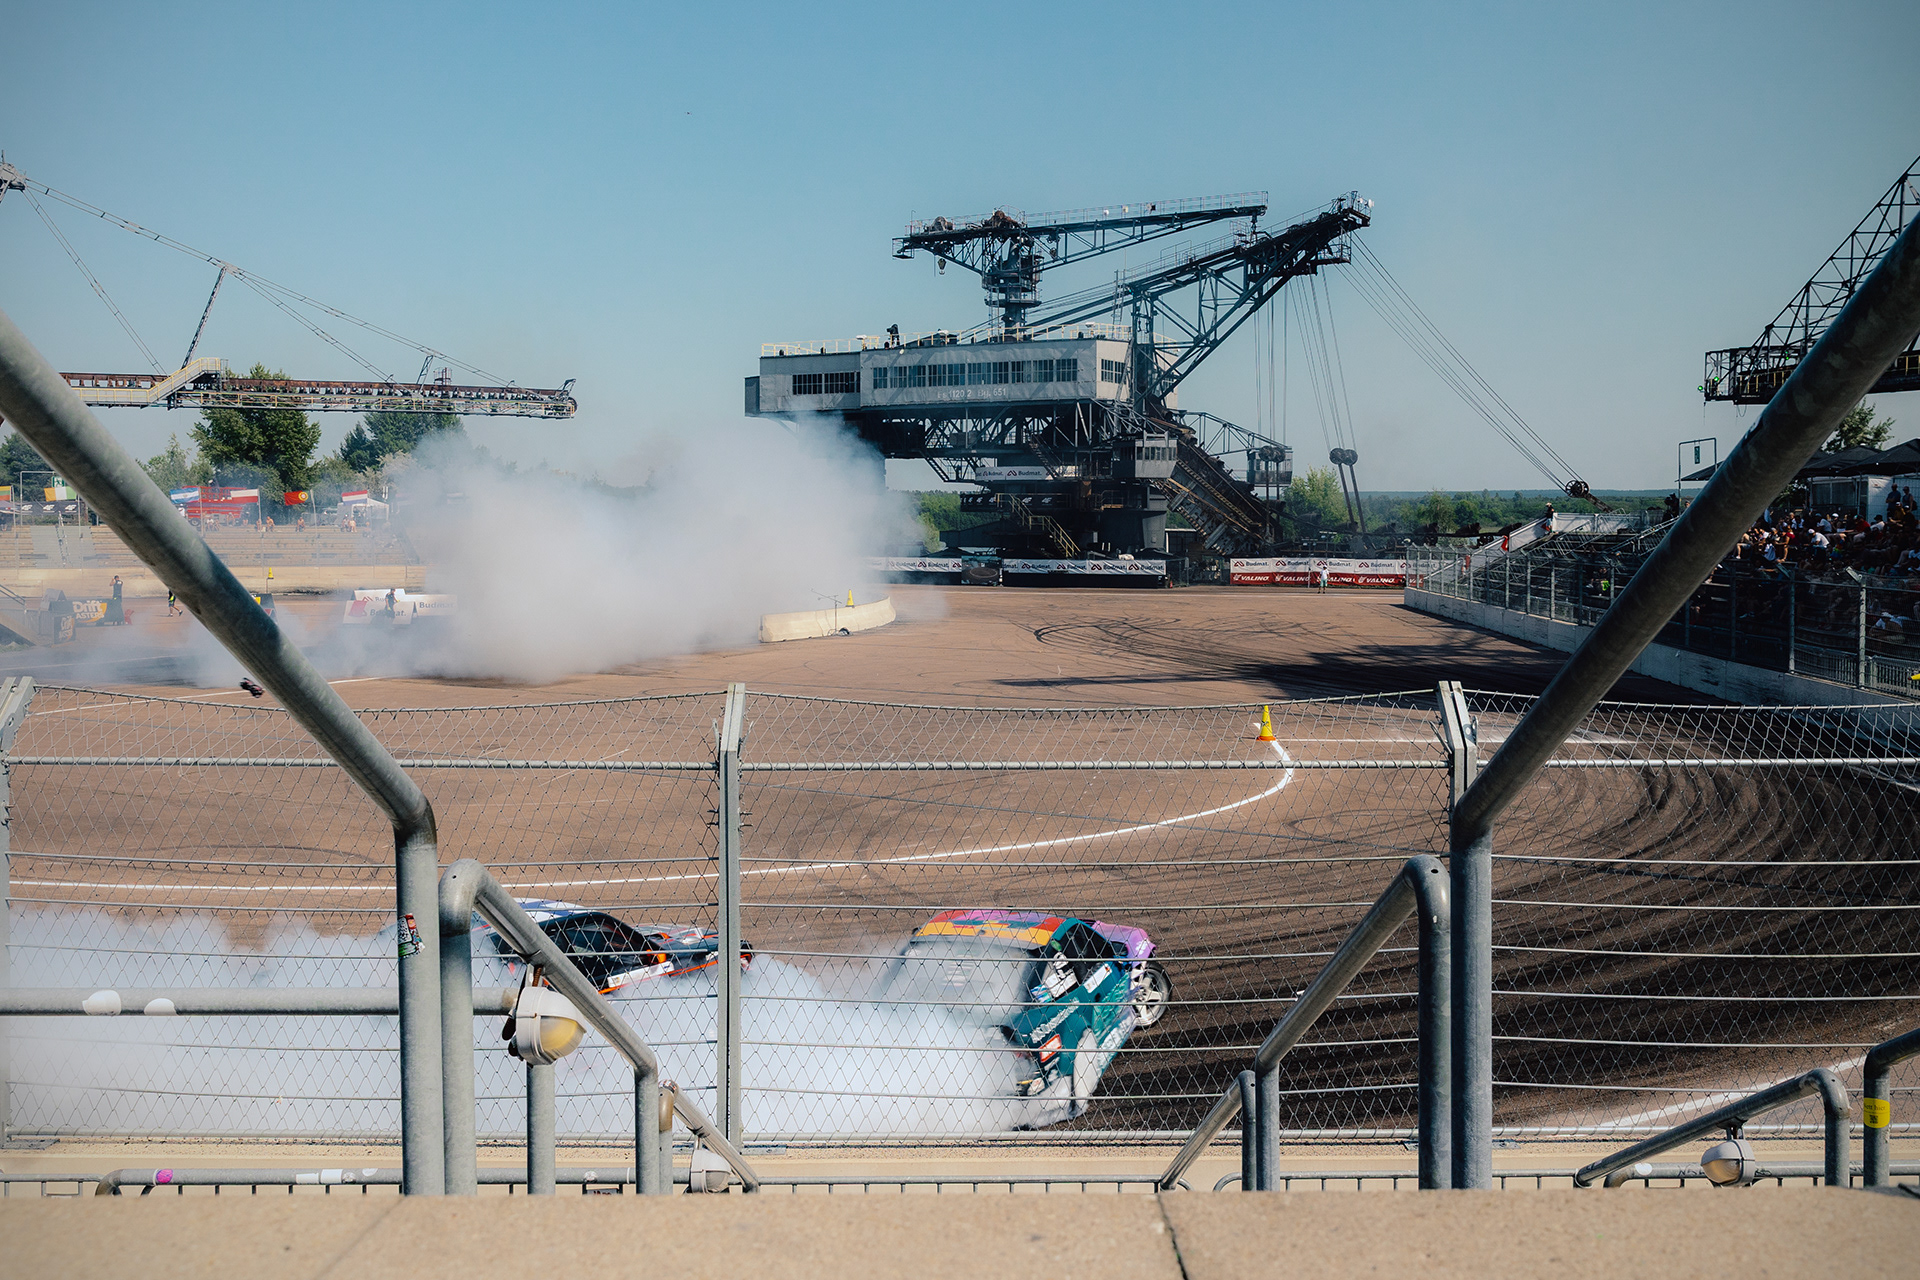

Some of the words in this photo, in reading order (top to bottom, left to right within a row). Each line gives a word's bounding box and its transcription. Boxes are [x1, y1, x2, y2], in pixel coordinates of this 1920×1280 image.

[993, 388, 1007, 396] 651
[72, 600, 104, 613] Drift
[370, 608, 407, 617] Bat.
